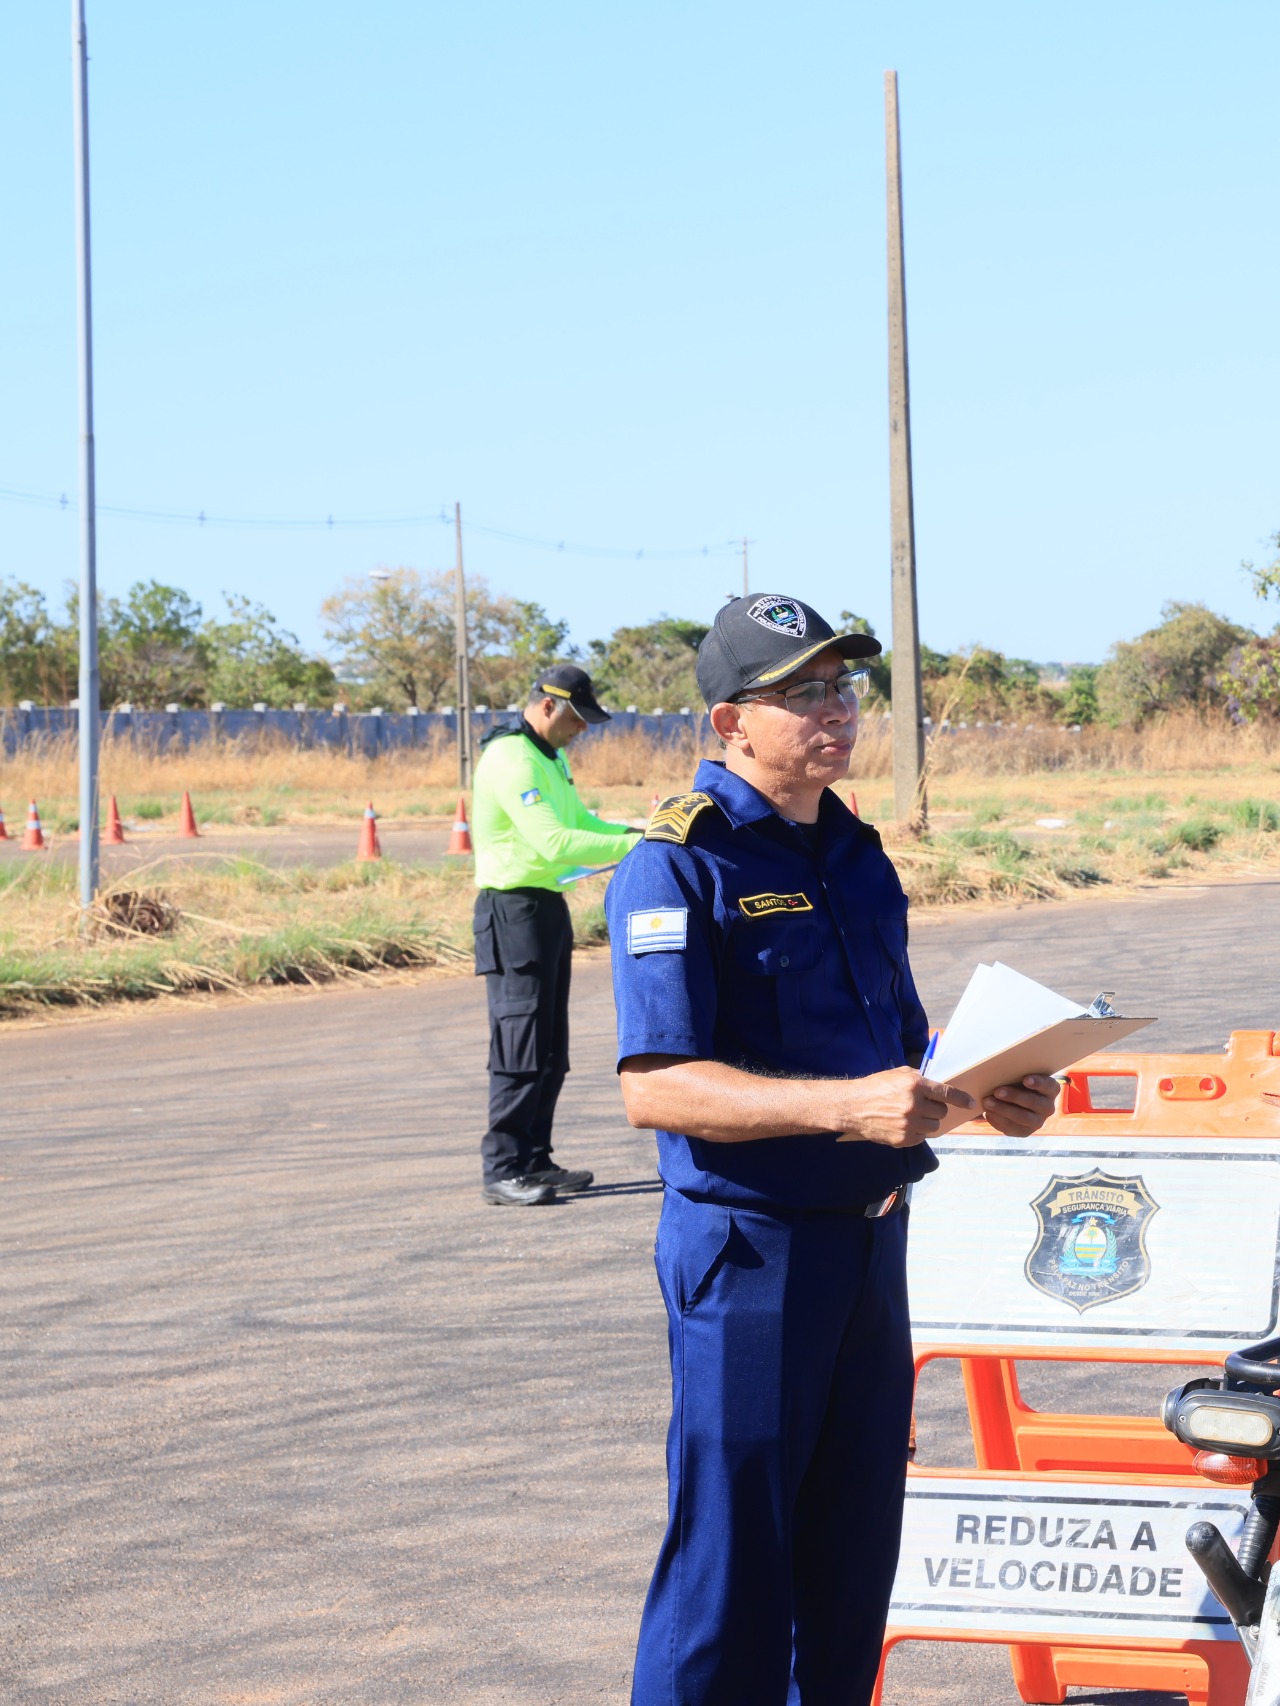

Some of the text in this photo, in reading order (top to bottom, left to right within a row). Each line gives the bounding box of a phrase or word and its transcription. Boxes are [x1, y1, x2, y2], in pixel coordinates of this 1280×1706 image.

[1062, 1202, 1105, 1214] SEGURANÇA
[1068, 1188, 1125, 1204] TRÂNSITO
[1049, 1259, 1063, 1282] PELA
[1061, 1276, 1078, 1290] PAZ
[1078, 1283, 1091, 1291] NO
[955, 1513, 1158, 1552] REDUZA A
[924, 1557, 1184, 1598] VELOCIDADE
